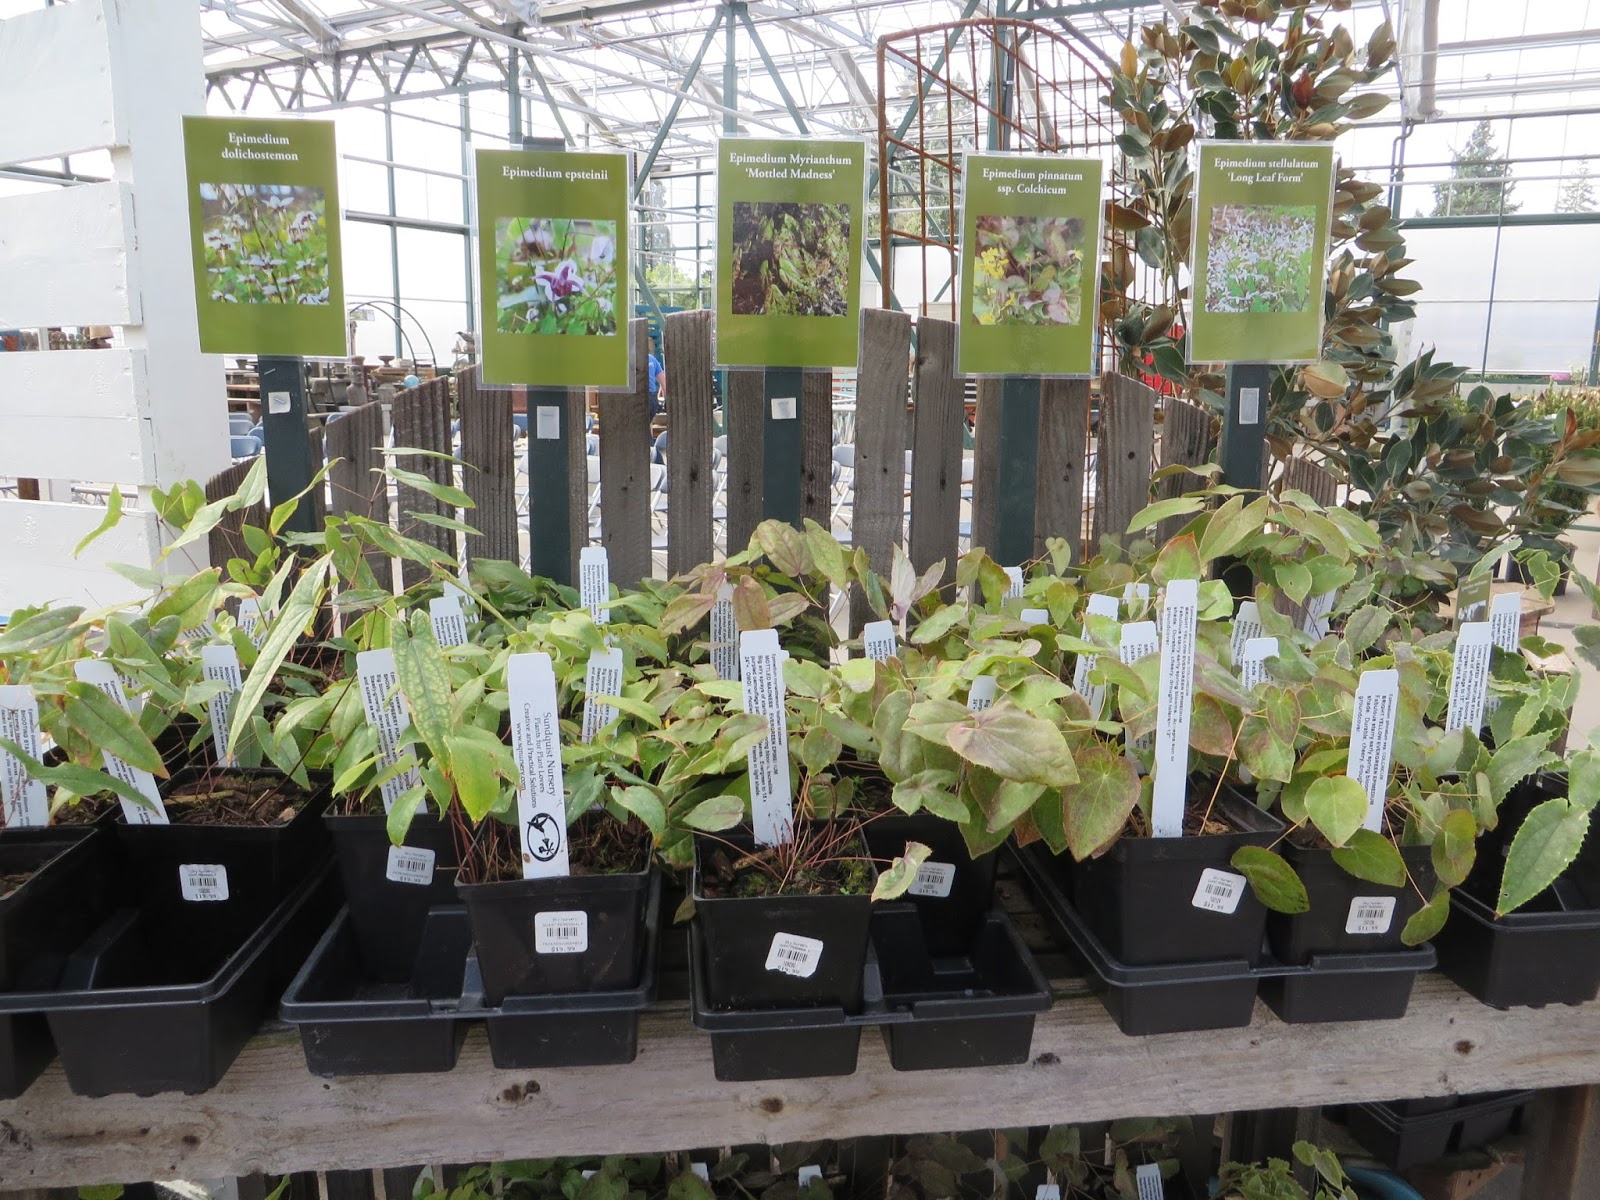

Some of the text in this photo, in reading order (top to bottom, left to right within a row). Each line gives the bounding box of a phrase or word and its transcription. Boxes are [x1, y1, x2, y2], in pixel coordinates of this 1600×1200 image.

[228, 132, 290, 146] Epimedium
[221, 148, 299, 161] dolichostemon
[729, 153, 852, 167] Epimedium Myrianthum
[1214, 158, 1319, 169] Epimedium stellulatum
[502, 166, 609, 182] Epimedium epsteinii
[982, 168, 1083, 182] Epimedium pinnatum
[1256, 172, 1276, 182] Leaf
[997, 184, 1067, 196] ssp. Colchicum
[1368, 723, 1376, 739] starry
[541, 712, 556, 795] Sundquist Nursery
[527, 748, 535, 774] Practical
[1364, 756, 1372, 773] spring
[1369, 776, 1377, 805] EPIMEDIUM
